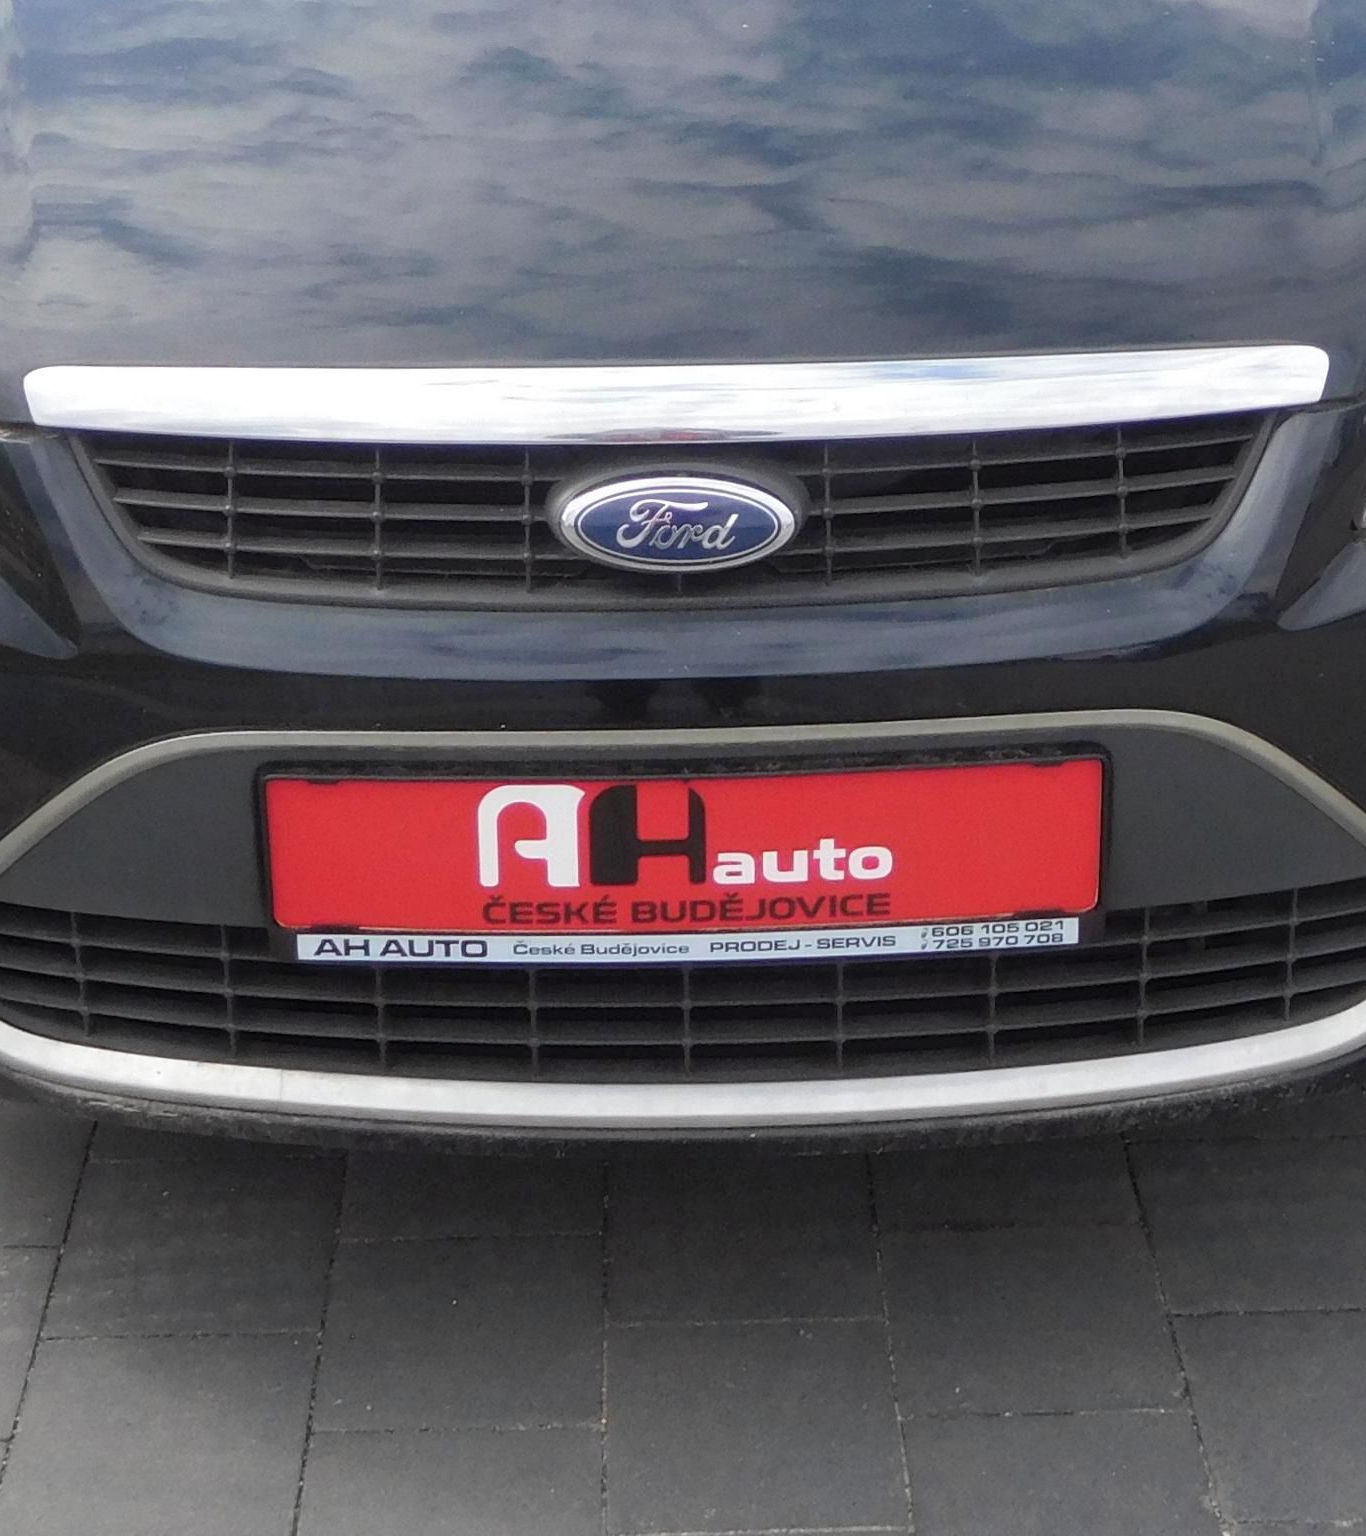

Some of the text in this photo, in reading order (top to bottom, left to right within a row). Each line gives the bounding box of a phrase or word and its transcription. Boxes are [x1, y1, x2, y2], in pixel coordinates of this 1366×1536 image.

[616, 498, 739, 550] Ford
[482, 892, 892, 926] ČESKÉ BUDĚJOVICE
[932, 920, 1064, 937] 606 105 021
[314, 939, 370, 957] AH
[379, 939, 488, 958] AUTO
[512, 939, 576, 956] České
[580, 940, 690, 957] Budějovice
[710, 939, 801, 954] PRODEJ
[817, 935, 897, 950] SERVIS
[933, 933, 1064, 950] 725 970 708
